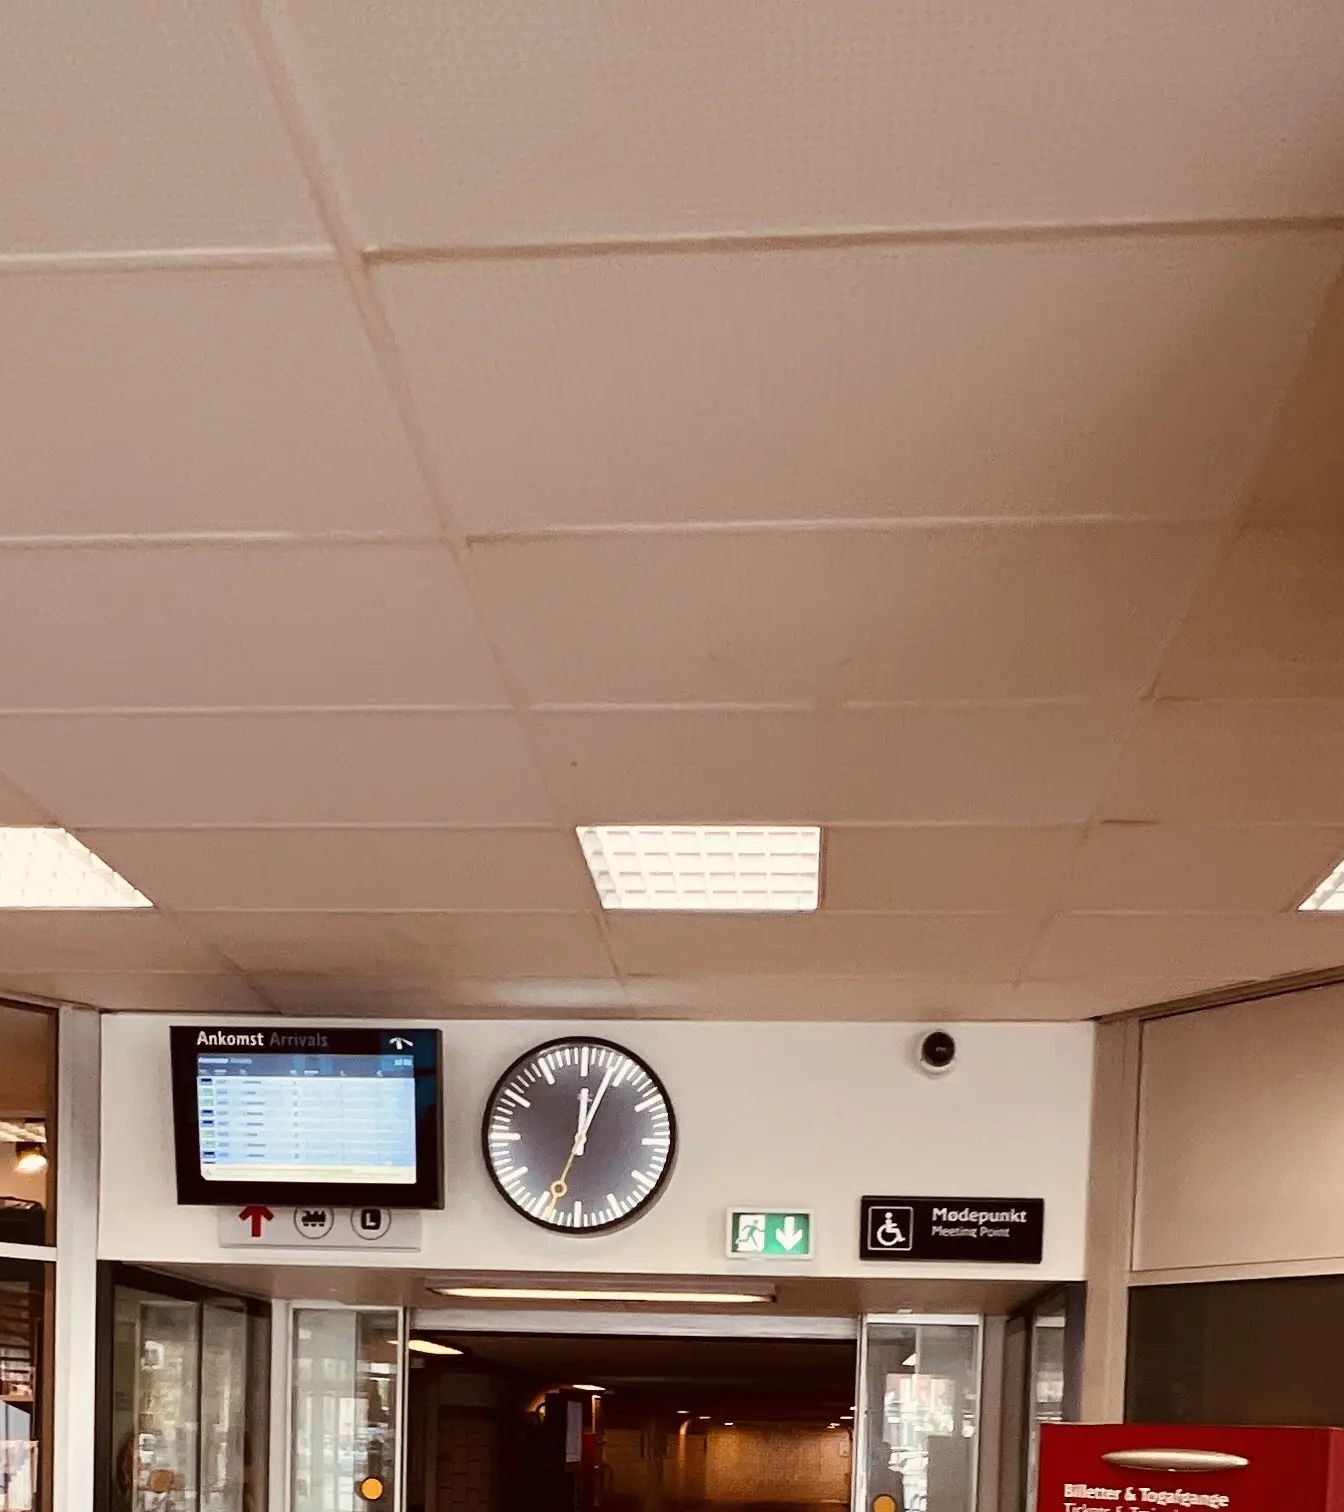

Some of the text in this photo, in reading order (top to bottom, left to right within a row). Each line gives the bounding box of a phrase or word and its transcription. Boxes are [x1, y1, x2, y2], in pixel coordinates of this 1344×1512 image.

[197, 1031, 329, 1047] Ankomst Arrivals
[932, 1208, 1028, 1225] Mødepunkt
[931, 1226, 1011, 1239] Meeting Point
[1064, 1484, 1230, 1509] Billetter & Togafgange
